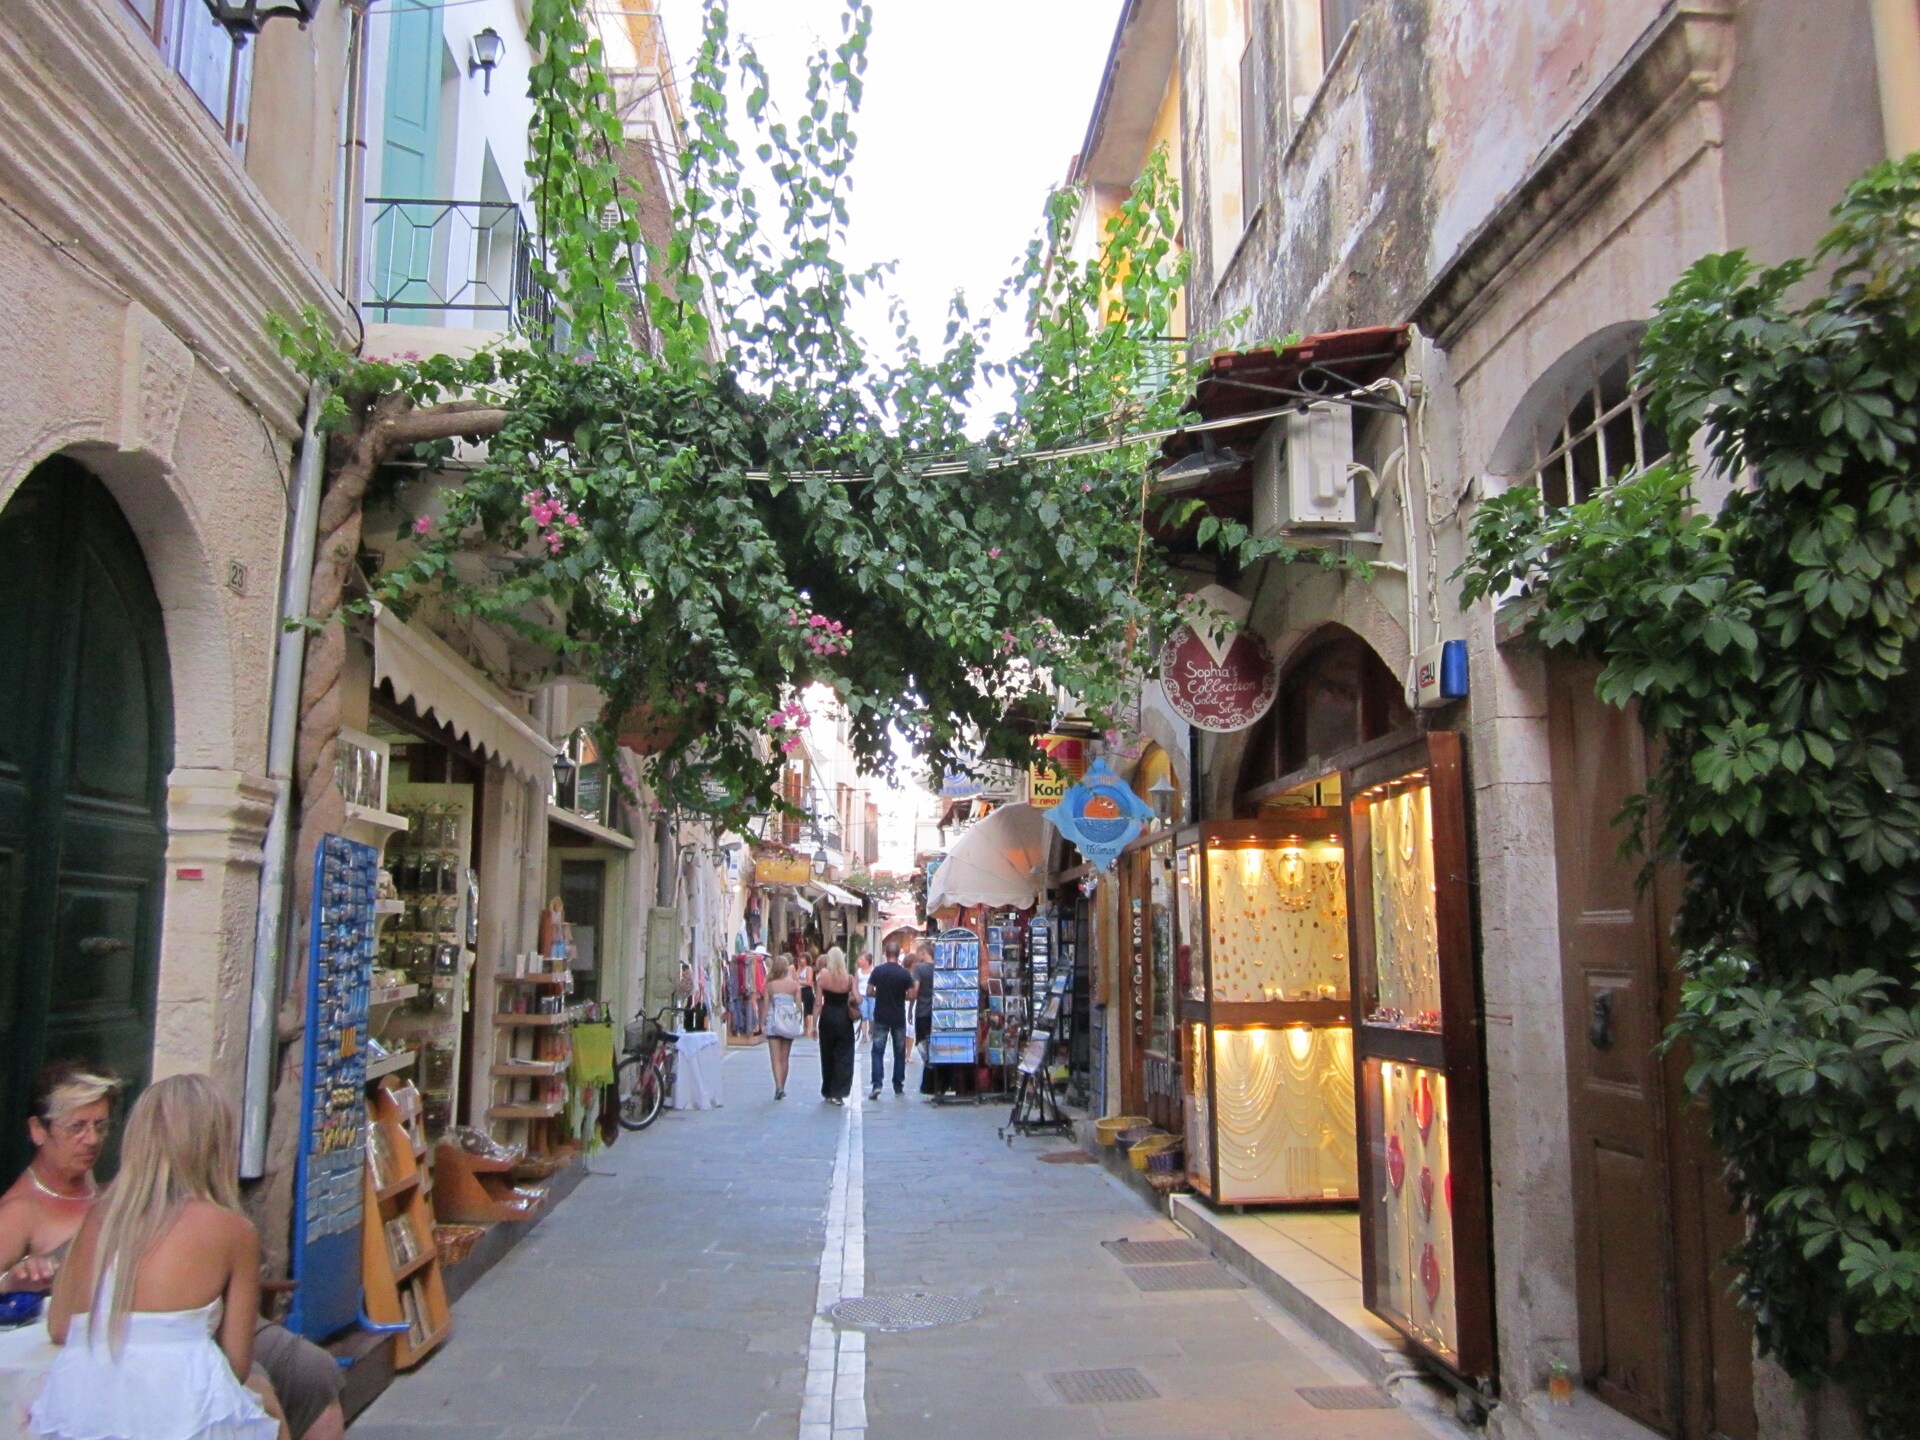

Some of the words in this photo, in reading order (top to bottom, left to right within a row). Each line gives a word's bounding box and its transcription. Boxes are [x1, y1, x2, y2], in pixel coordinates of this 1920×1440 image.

[231, 565, 244, 588] 23
[1184, 660, 1238, 682] Sophia's
[1187, 678, 1256, 694] Collection
[1034, 783, 1067, 796] Kod
